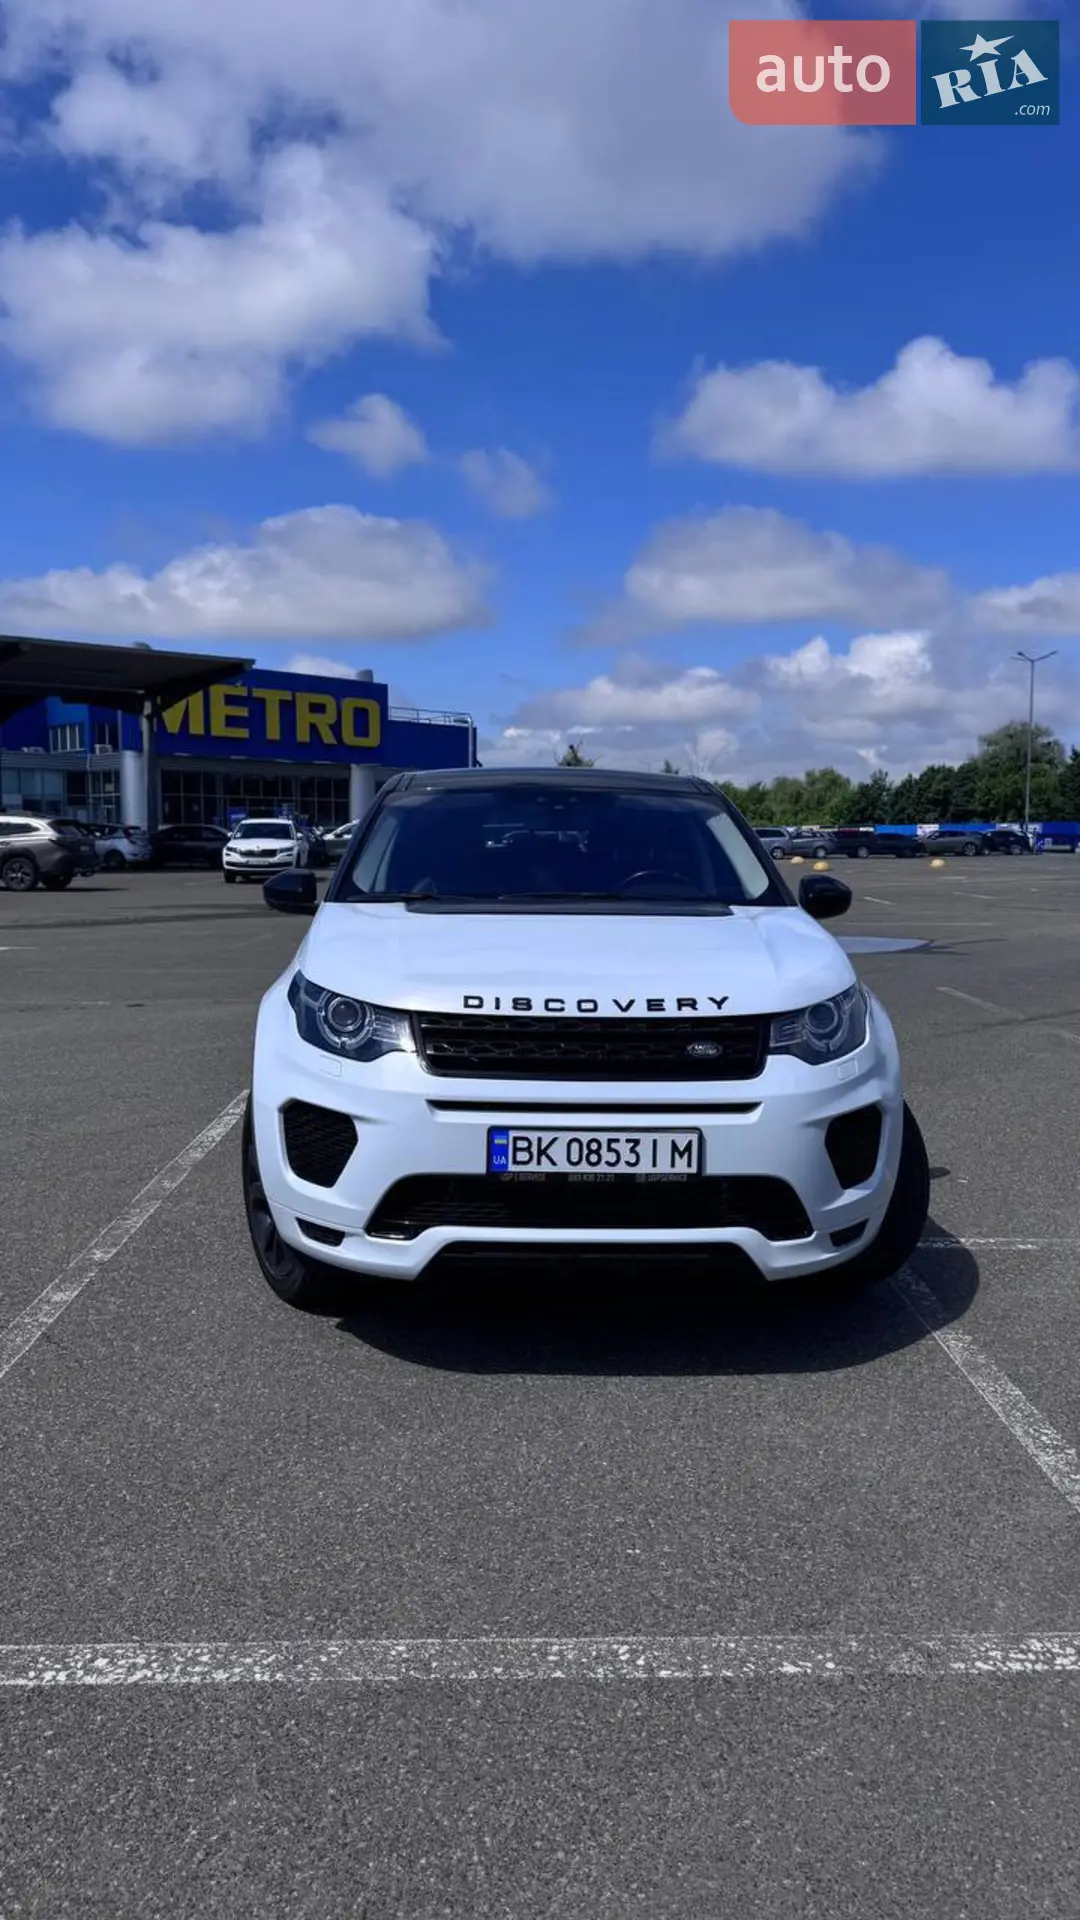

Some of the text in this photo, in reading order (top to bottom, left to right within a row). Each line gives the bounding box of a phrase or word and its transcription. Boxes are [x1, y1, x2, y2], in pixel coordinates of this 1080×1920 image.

[463, 995, 730, 1013] DISCOVERY
[493, 1156, 507, 1165] UA
[512, 1136, 559, 1166] BK
[566, 1137, 641, 1168] 0853
